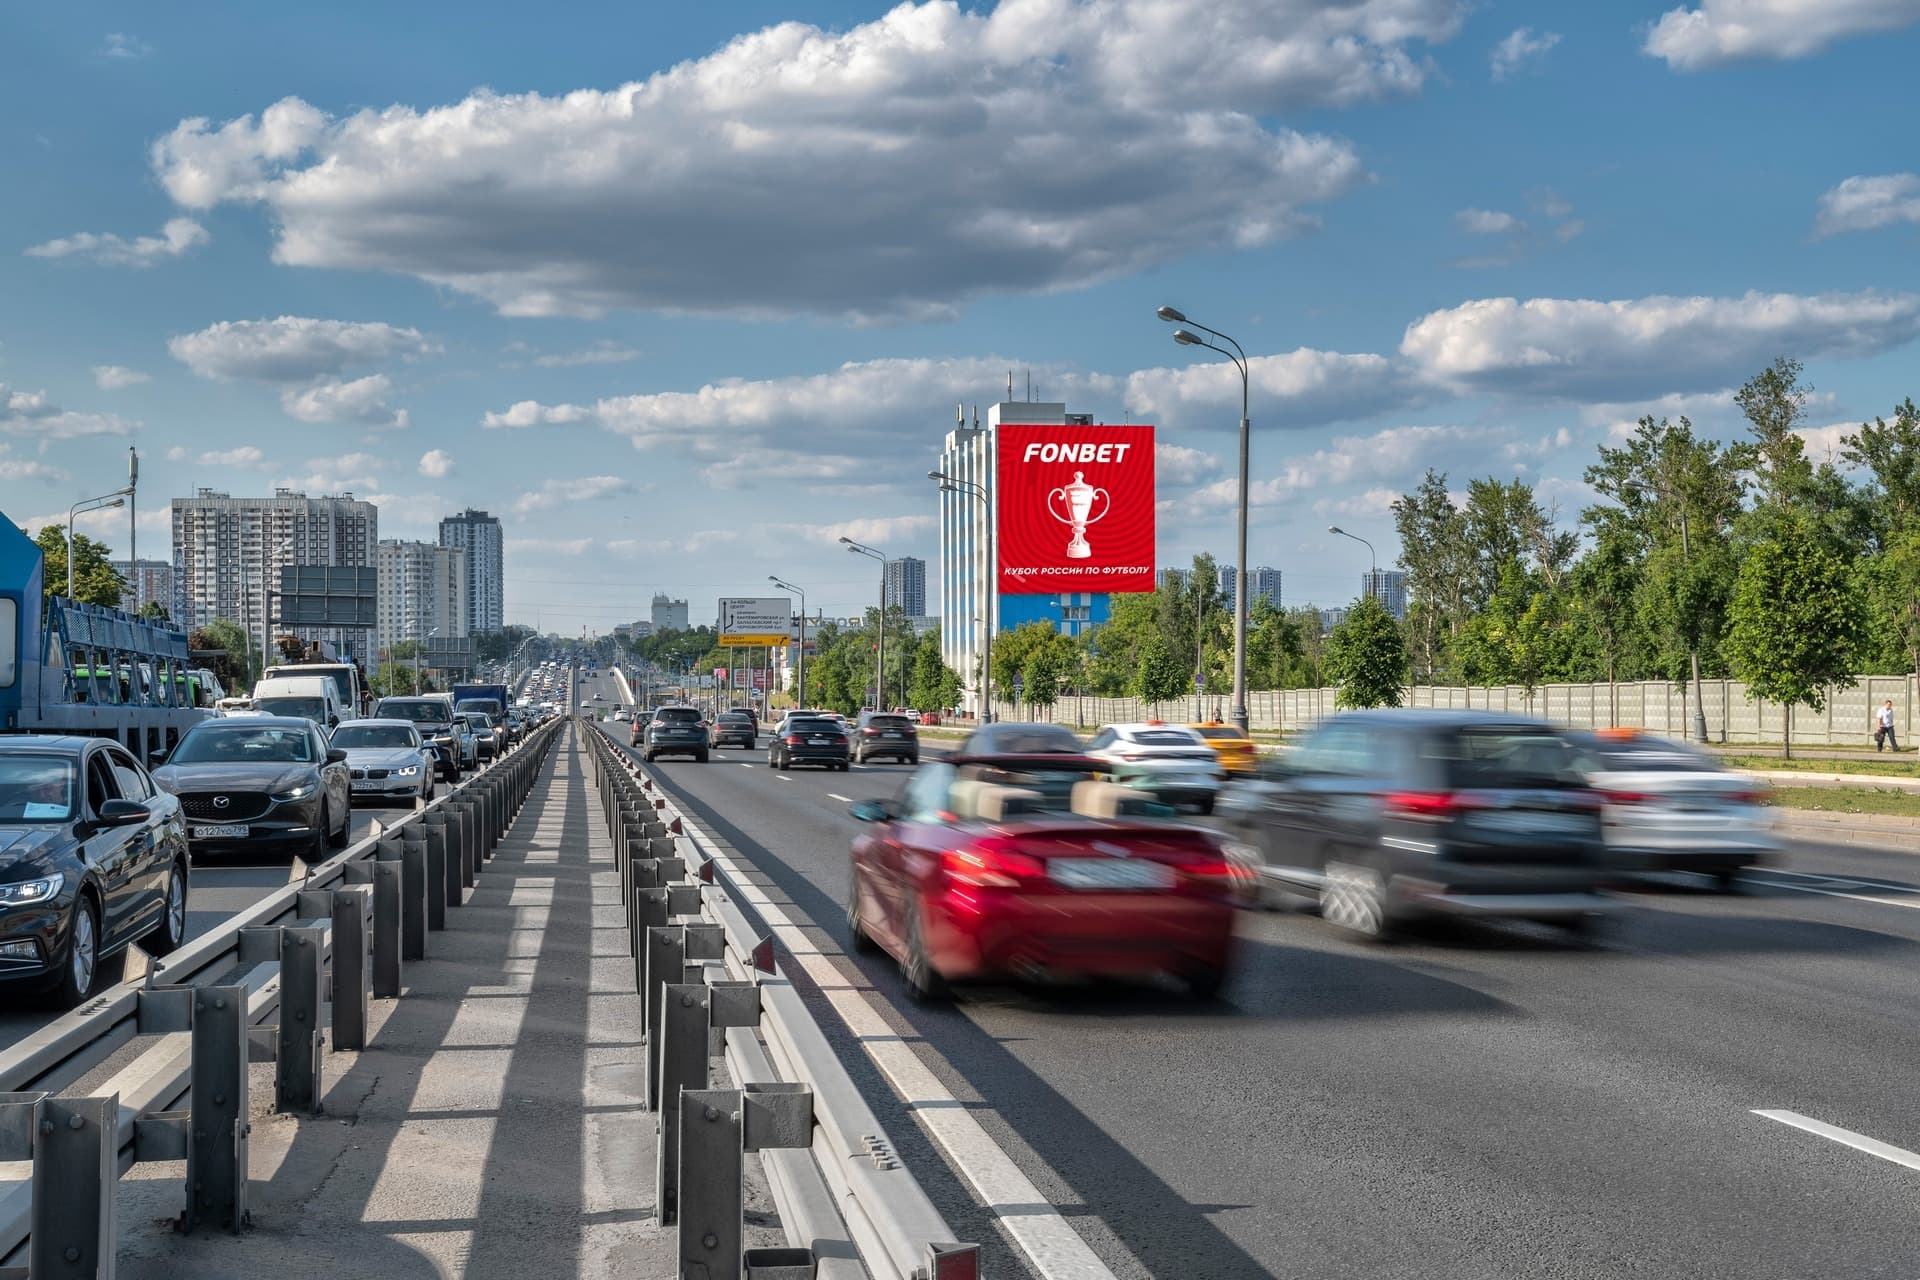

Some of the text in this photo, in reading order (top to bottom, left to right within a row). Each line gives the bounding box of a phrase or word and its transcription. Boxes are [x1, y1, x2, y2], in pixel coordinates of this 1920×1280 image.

[1023, 443, 1130, 463] FONBET
[1004, 566, 1150, 575] КУБОК РОССИИ ПО ФУТБОЛУ
